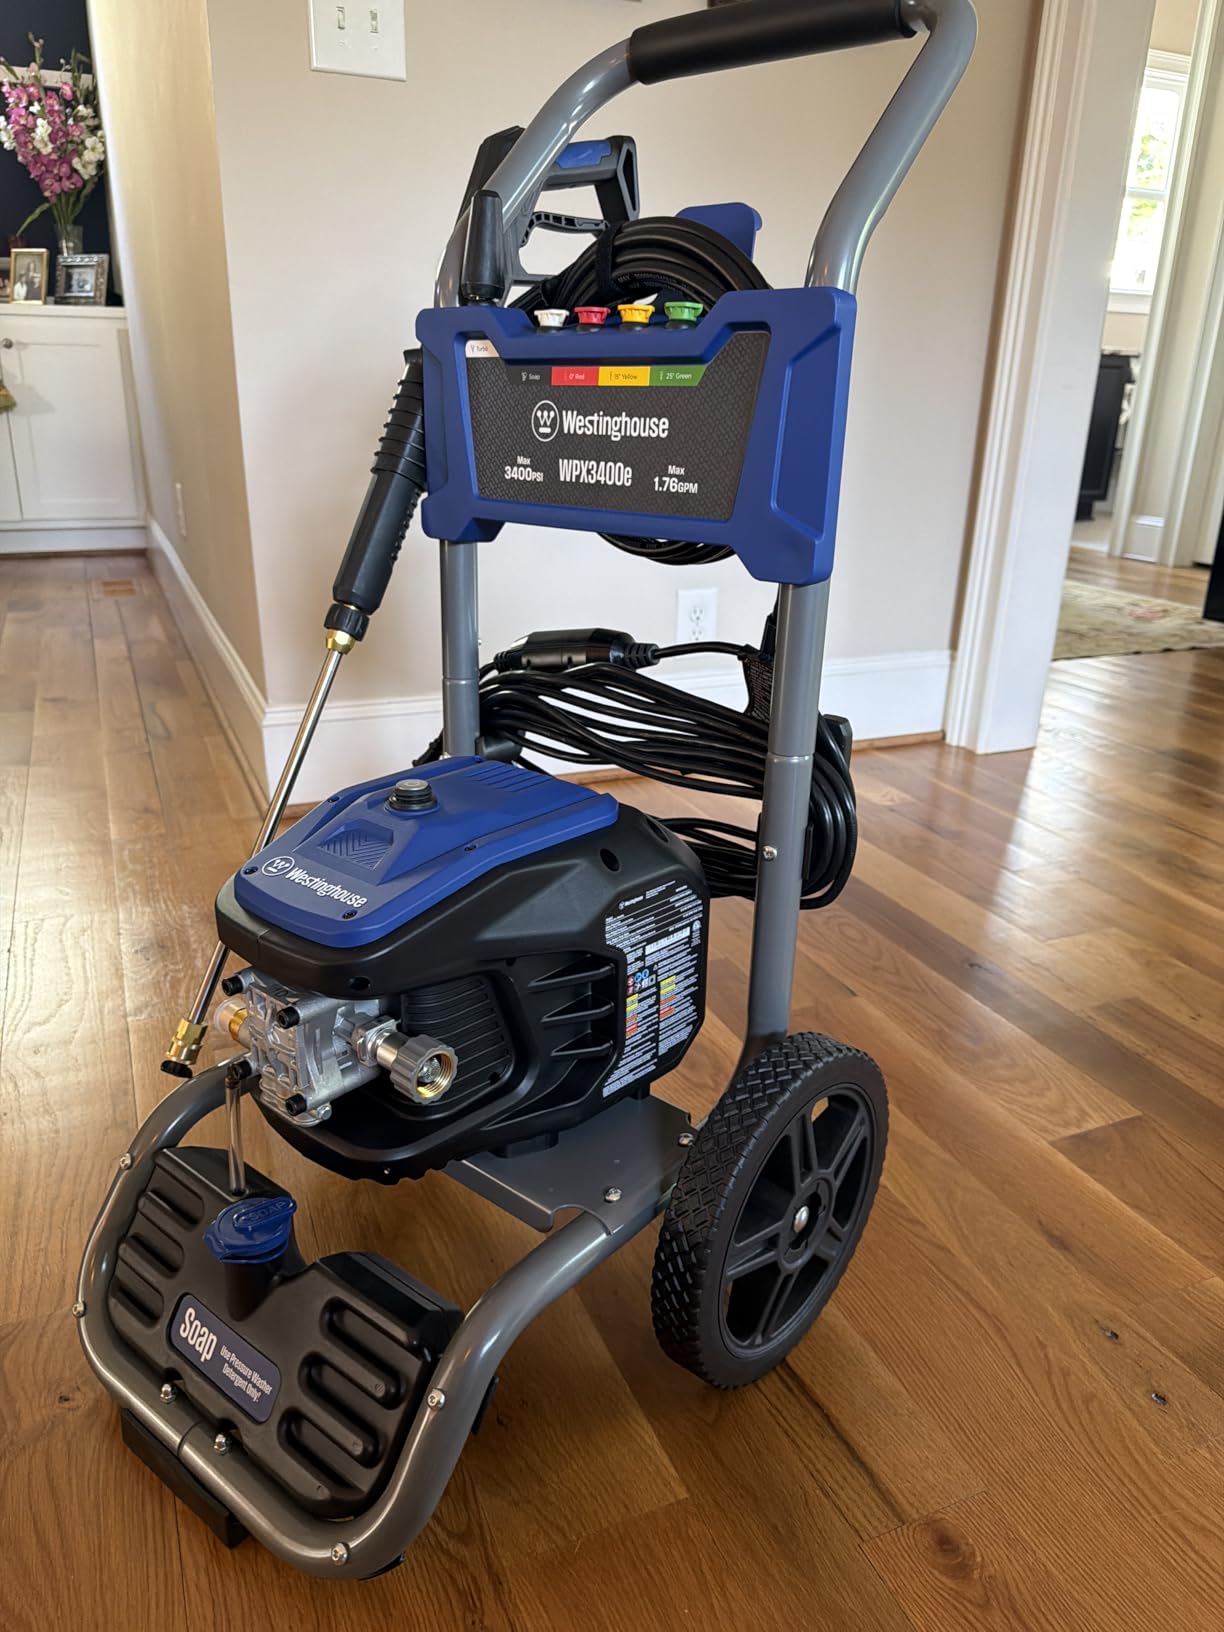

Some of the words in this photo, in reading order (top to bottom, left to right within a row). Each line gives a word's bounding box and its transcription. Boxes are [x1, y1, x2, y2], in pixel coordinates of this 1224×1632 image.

[528, 373, 541, 381] Soap
[666, 372, 675, 380] 25°
[675, 372, 692, 380] Green
[562, 409, 669, 441] Westinghouse
[516, 455, 531, 465] Max
[558, 458, 633, 486] WPX3400e
[668, 465, 685, 476] Max
[285, 866, 368, 908] Westinghouse
[248, 1201, 287, 1220] SOAP
[179, 1307, 218, 1363] Soap
[220, 1344, 232, 1361] Use
[229, 1352, 253, 1379] Pressure
[251, 1370, 273, 1395] Washer
[222, 1362, 249, 1392] Detergent
[246, 1383, 262, 1402] Only!
